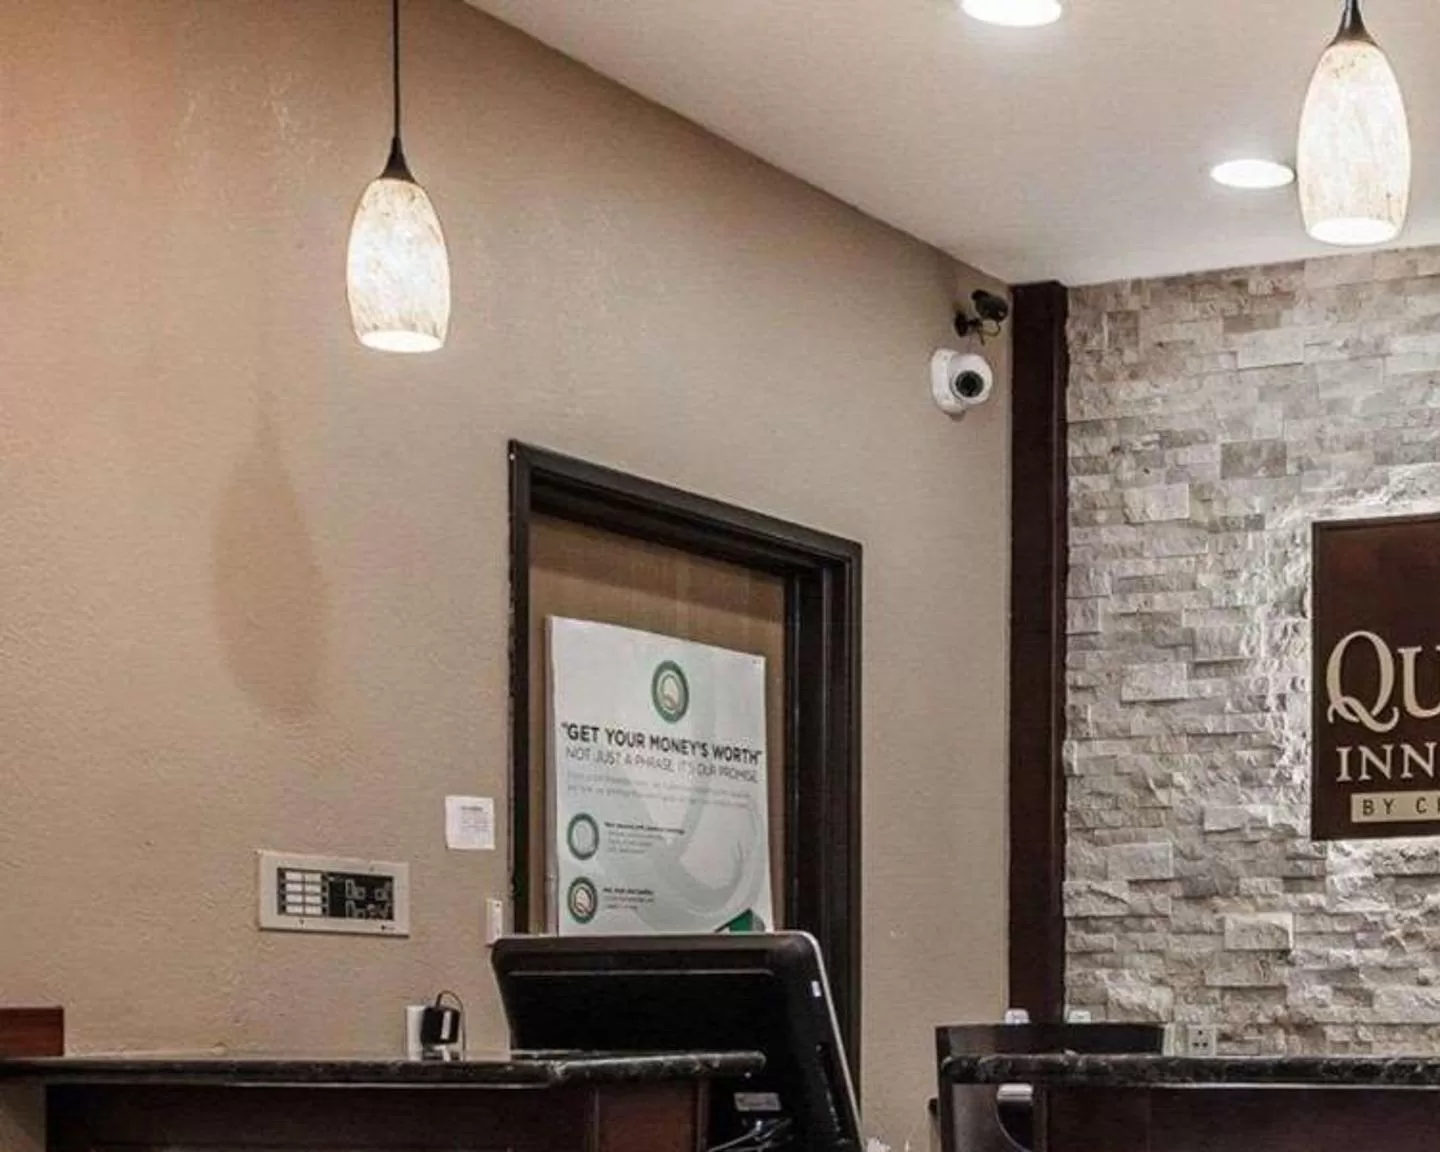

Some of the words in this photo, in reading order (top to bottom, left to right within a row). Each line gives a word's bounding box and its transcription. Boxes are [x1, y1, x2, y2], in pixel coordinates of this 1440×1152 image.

[604, 727, 645, 749] YOUR
[649, 733, 709, 758] MONEY'S
[1335, 741, 1438, 783] INN
[1362, 798, 1396, 817] BY
